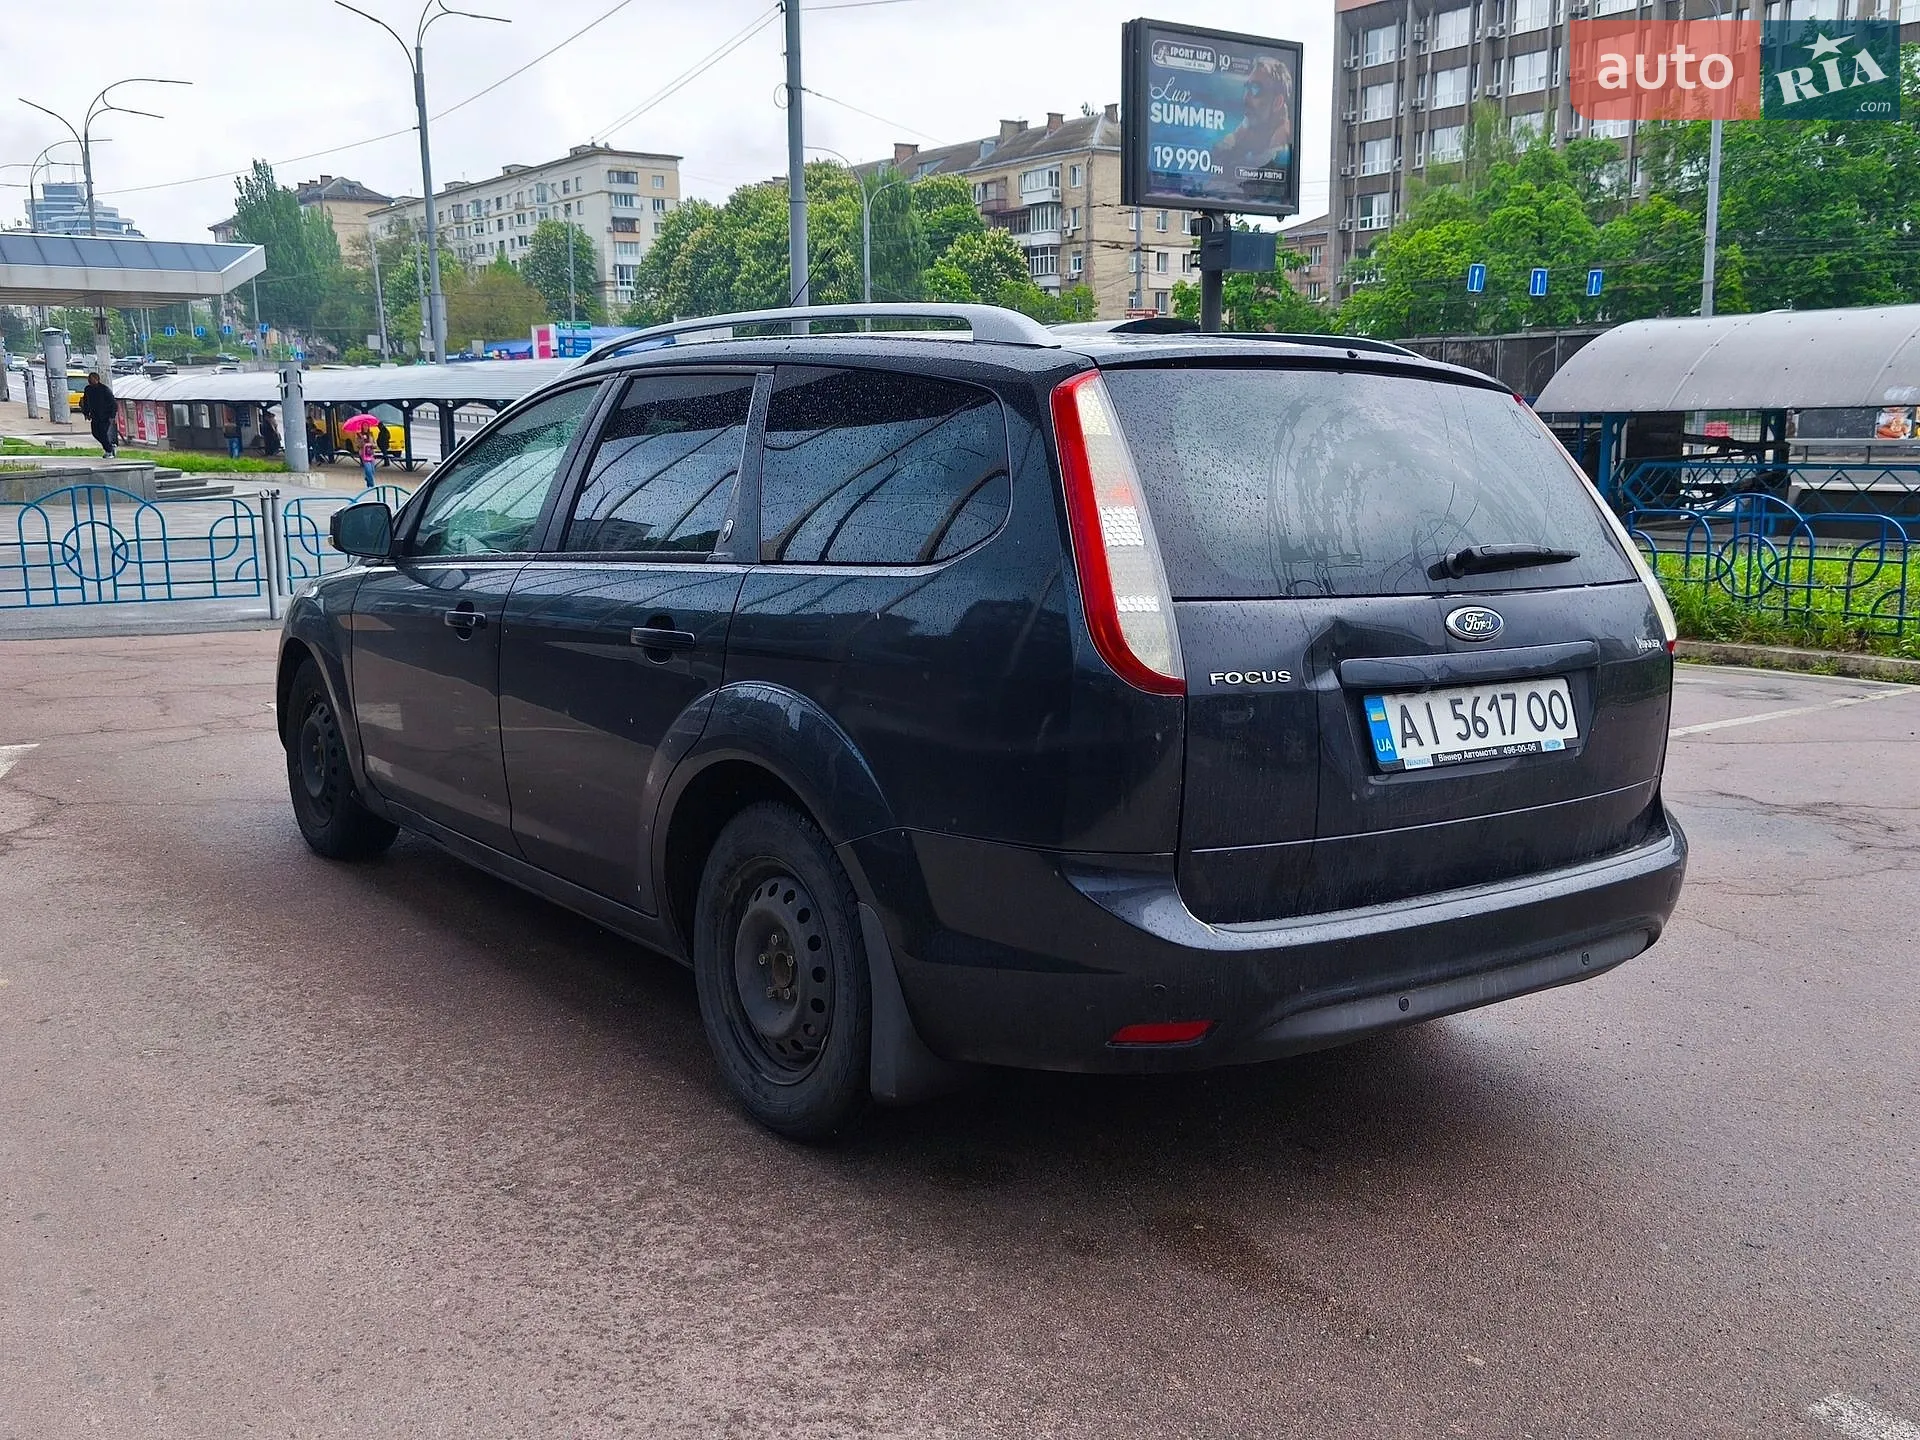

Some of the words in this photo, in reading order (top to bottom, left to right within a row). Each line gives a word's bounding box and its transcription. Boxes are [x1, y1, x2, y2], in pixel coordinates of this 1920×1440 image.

[1170, 46, 1194, 60] SPORT
[1196, 50, 1212, 62] LIFE
[1149, 76, 1191, 103] Lux
[1150, 102, 1225, 131] SUMMER
[1463, 611, 1495, 633] Ford
[1209, 670, 1292, 687] FOCUS
[1450, 692, 1518, 741] 5617
[1376, 738, 1395, 753] UA
[1437, 752, 1463, 764] Віннер
